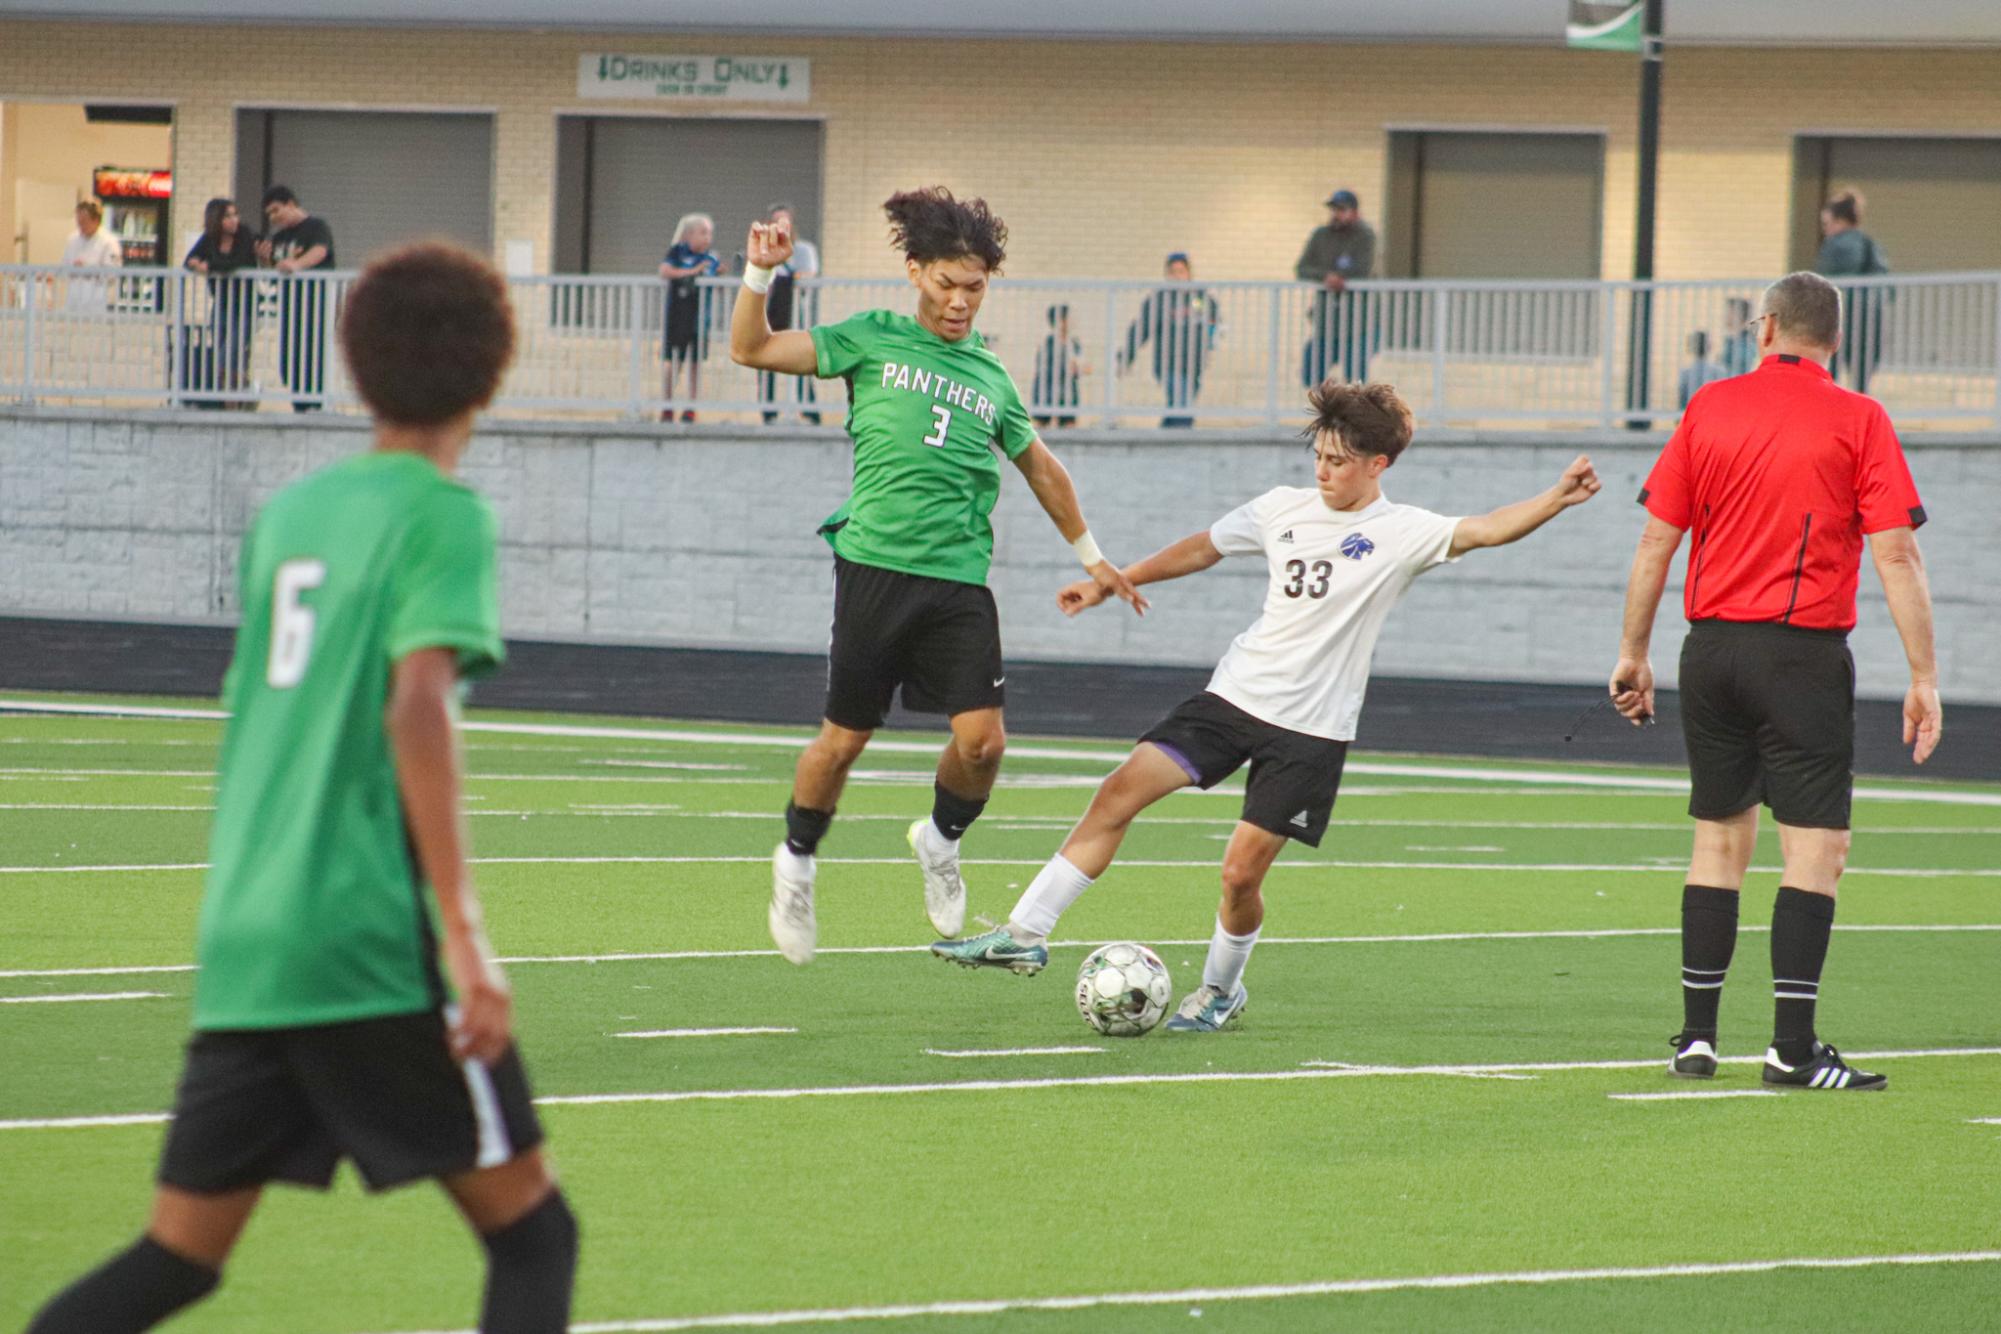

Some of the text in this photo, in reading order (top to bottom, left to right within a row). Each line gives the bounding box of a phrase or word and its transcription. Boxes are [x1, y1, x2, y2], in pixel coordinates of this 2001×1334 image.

[610, 56, 776, 83] DRINKS ONLY
[881, 361, 996, 427] PANTHERS
[923, 403, 952, 448] 3
[1283, 558, 1333, 600] 33
[266, 557, 327, 688] 6
